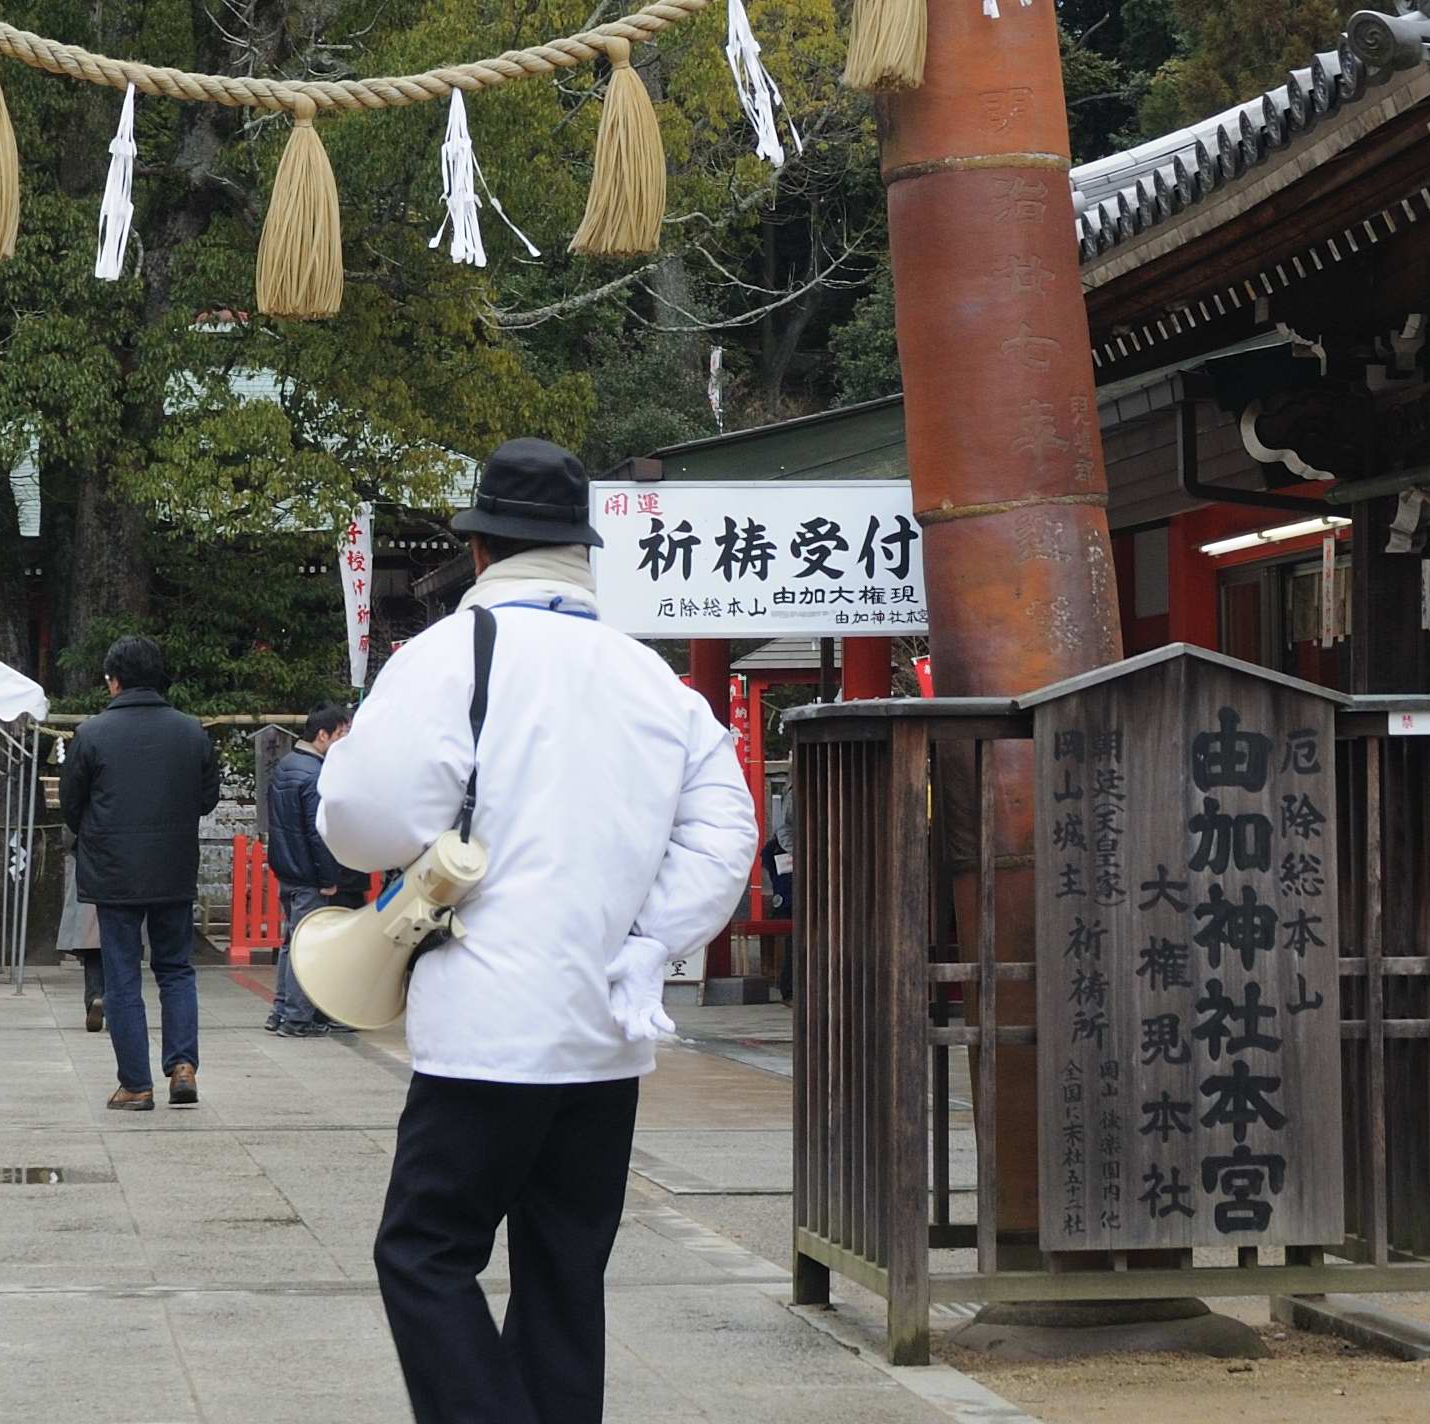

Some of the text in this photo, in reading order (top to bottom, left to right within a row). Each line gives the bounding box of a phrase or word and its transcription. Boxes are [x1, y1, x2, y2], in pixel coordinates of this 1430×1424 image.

[604, 492, 664, 516] 開運
[637, 514, 920, 583] 祈祷受付
[656, 596, 768, 619] 厄除総本山
[772, 584, 919, 606] 由加大権現
[1051, 729, 1089, 899] 岡山城主
[1278, 726, 1327, 1016] 厄除総本山
[1187, 706, 1289, 1235] 由加神社本宮
[1136, 862, 1197, 1221] 大権現本社
